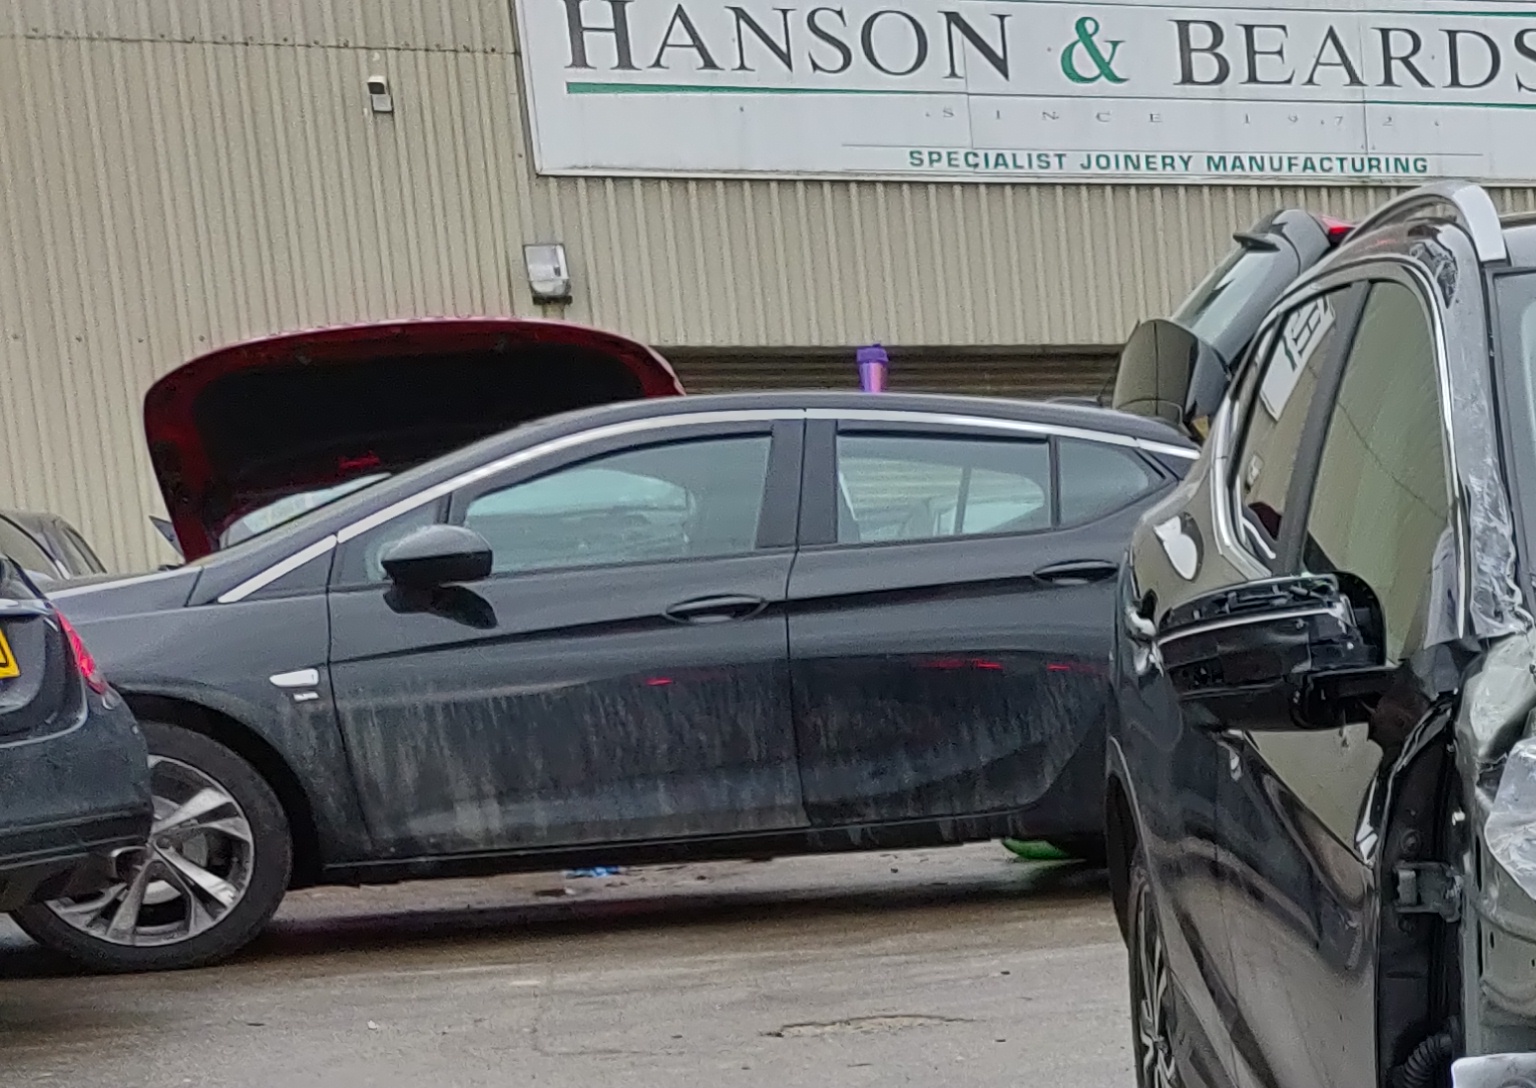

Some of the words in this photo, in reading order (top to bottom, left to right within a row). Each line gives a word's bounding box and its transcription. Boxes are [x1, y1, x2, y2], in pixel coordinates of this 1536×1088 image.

[563, 0, 1013, 82] HANSON
[1060, 16, 1130, 85] &
[908, 149, 1067, 171] SPECIALIST
[1079, 152, 1193, 173] JOINERY
[1206, 154, 1429, 174] MANUFACTURING
